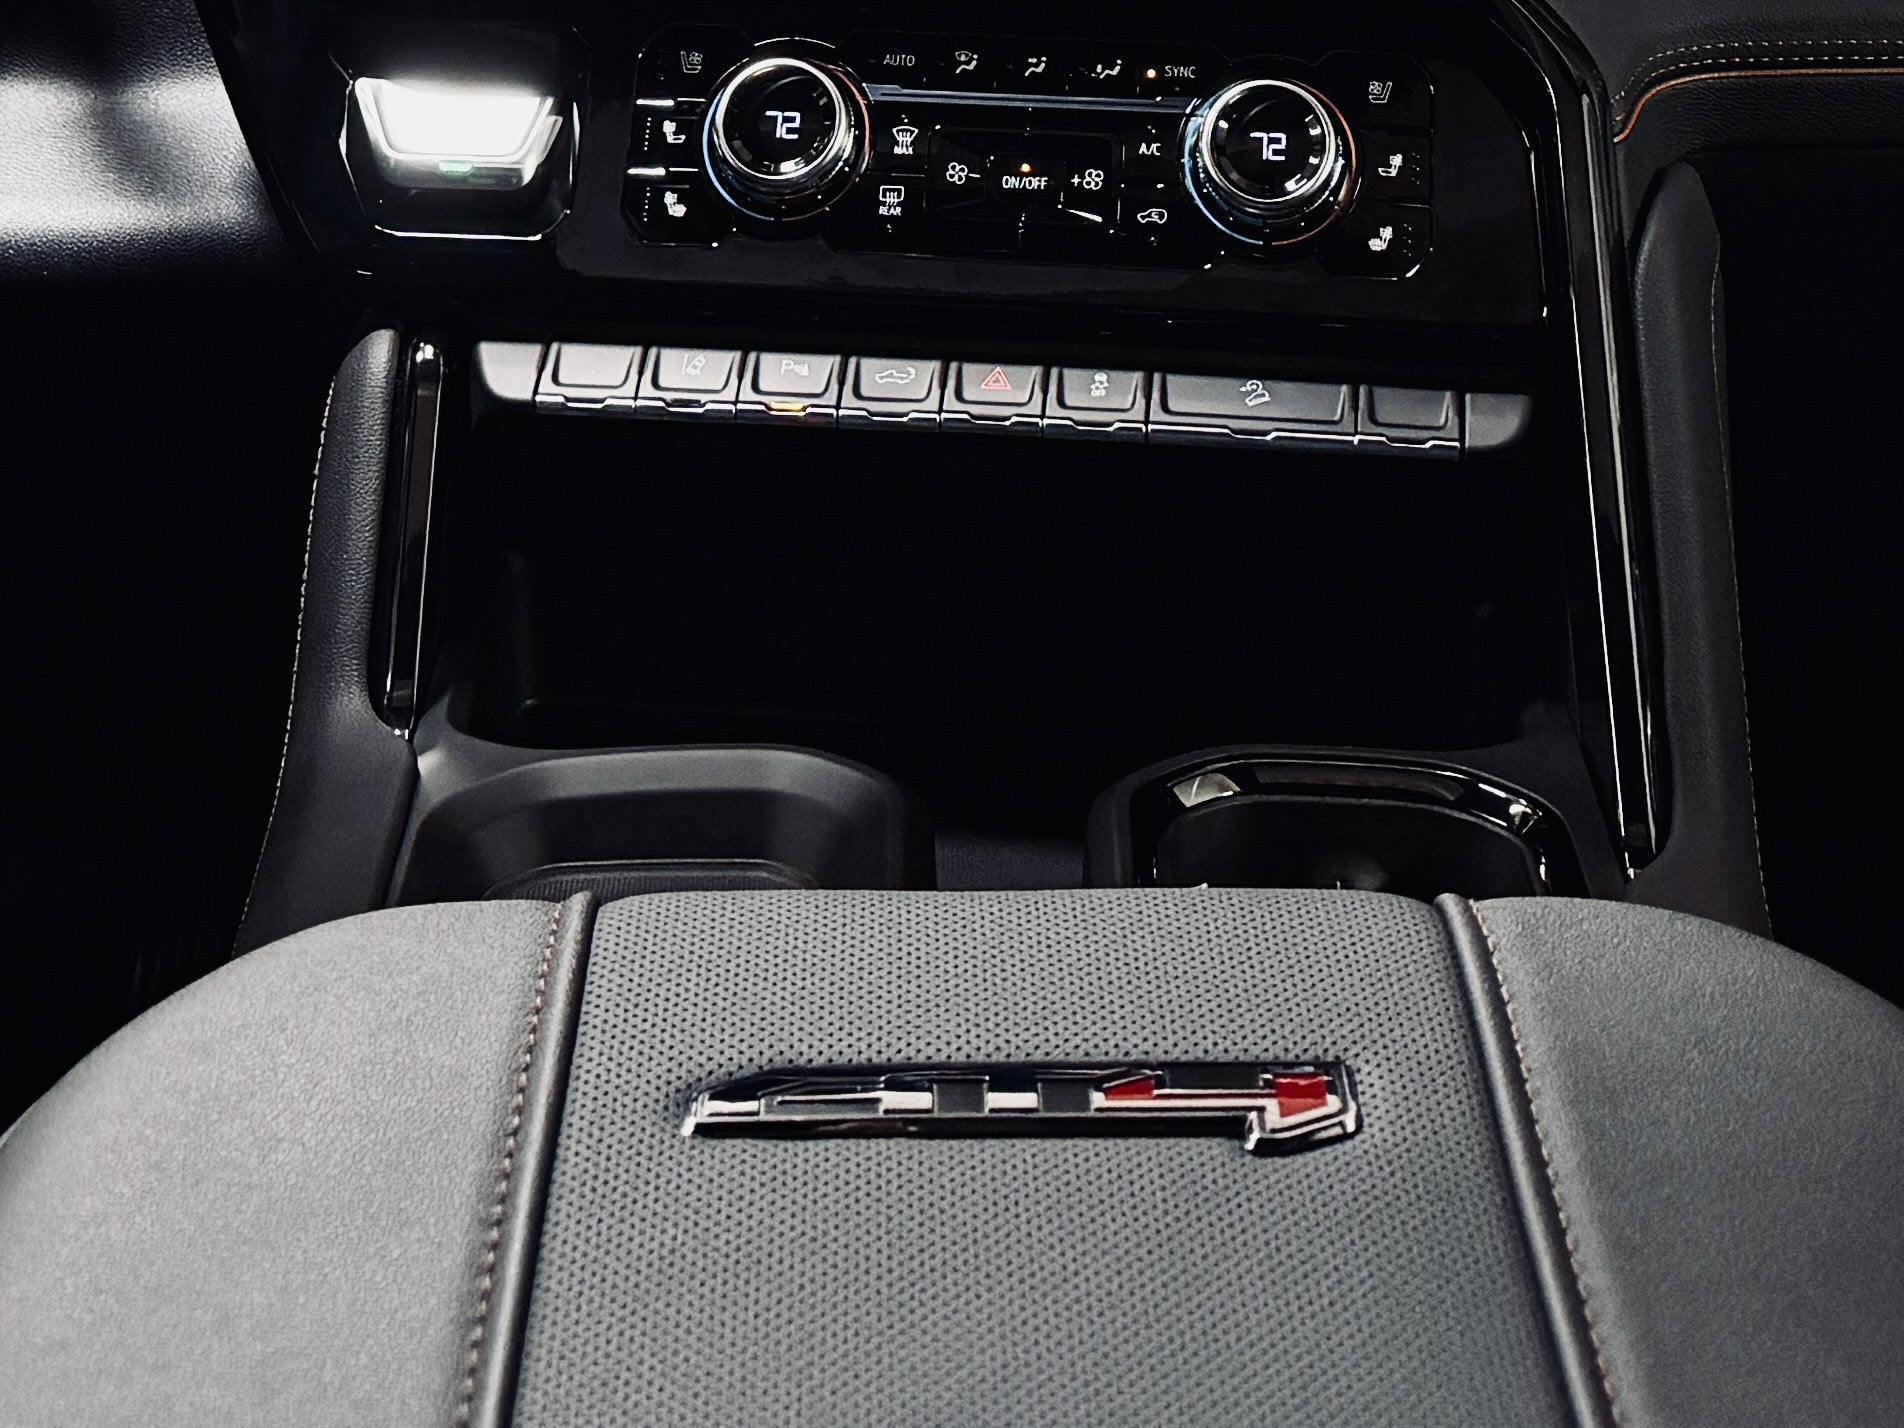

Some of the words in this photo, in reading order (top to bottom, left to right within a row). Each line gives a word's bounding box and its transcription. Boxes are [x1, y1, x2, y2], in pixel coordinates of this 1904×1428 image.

[882, 54, 916, 67] AUTO
[1164, 65, 1197, 79] SYNC
[764, 110, 801, 140] 72
[1138, 142, 1162, 156] A/C
[1249, 131, 1287, 161] 72
[1001, 176, 1049, 191] ON/OFF
[878, 205, 902, 216] REAR
